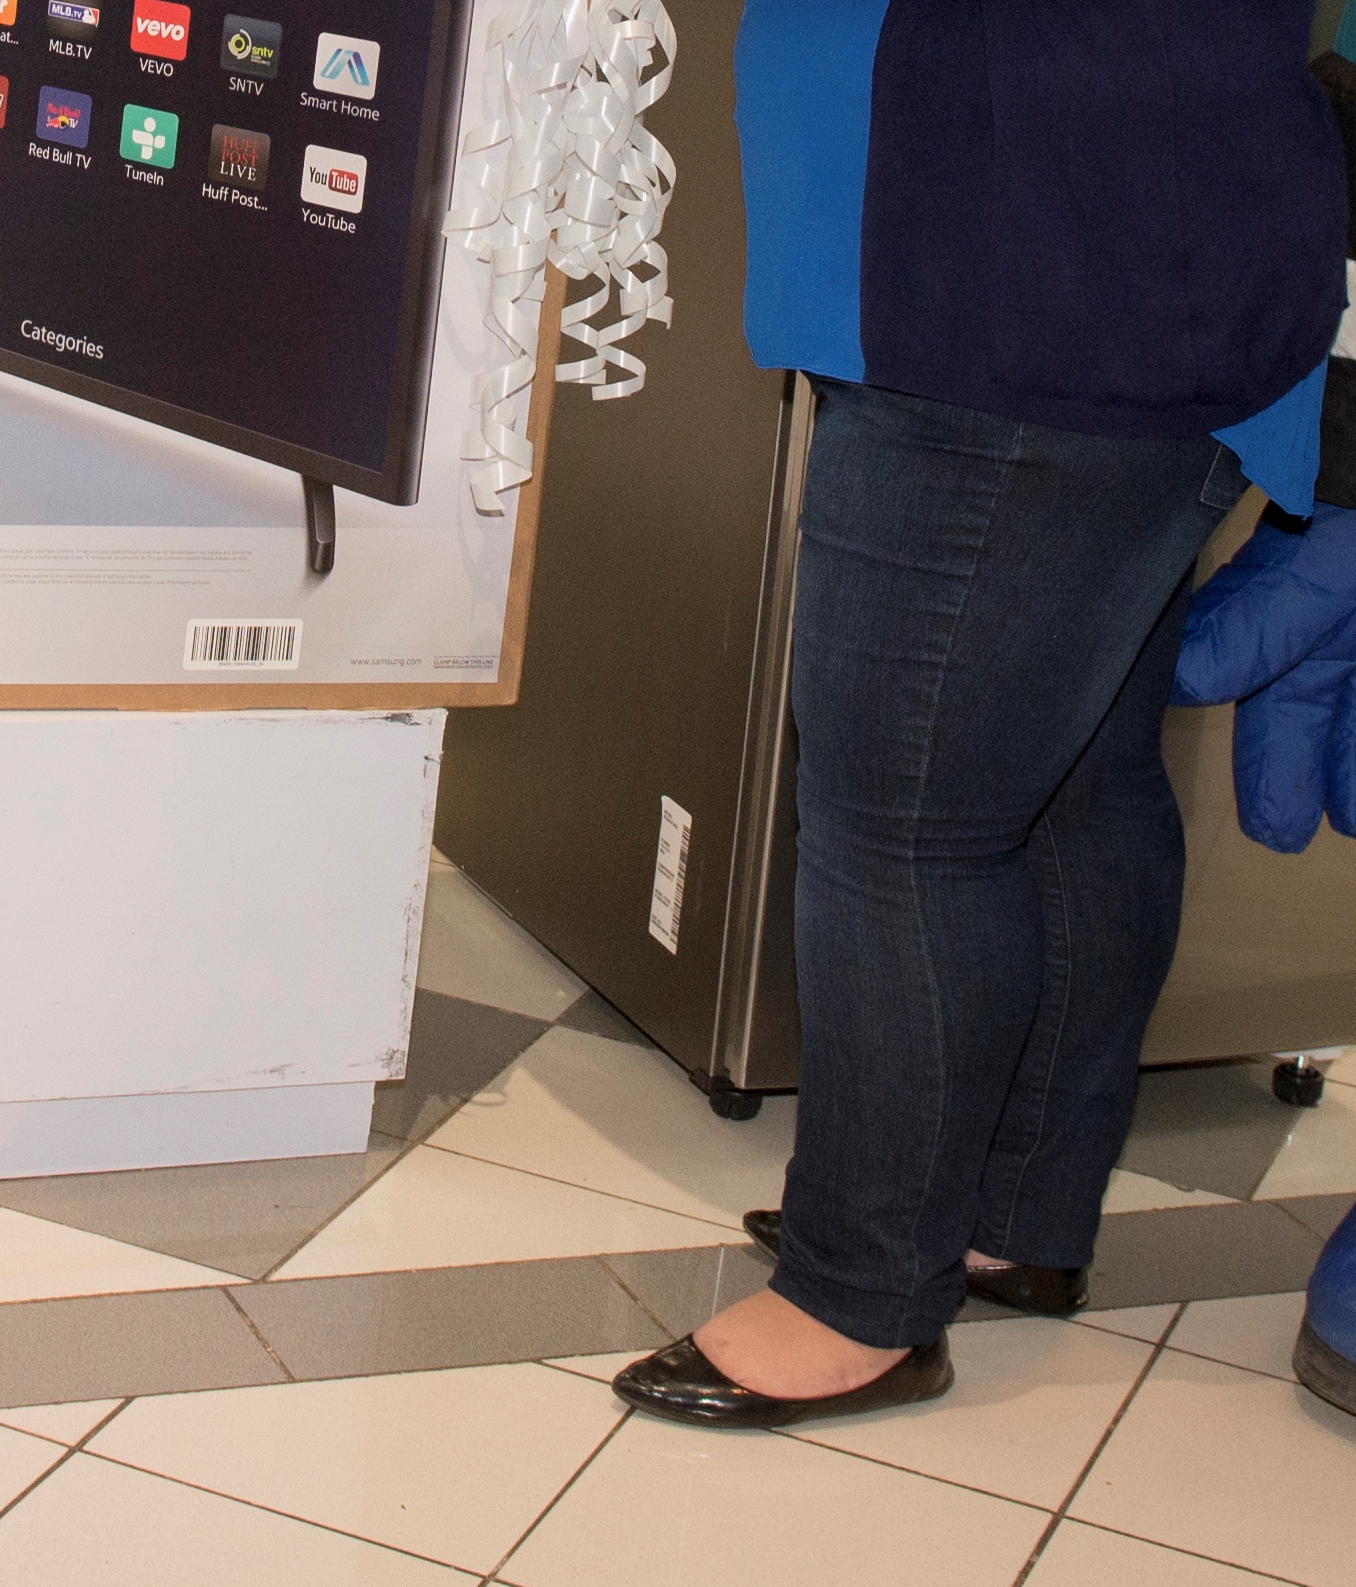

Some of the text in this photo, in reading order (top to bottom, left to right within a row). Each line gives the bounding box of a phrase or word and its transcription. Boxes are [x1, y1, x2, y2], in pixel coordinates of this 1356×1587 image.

[136, 17, 185, 41] vevo
[49, 39, 92, 60] MLB.TV
[252, 47, 273, 58] sntv
[139, 58, 173, 78] VEVO
[229, 77, 264, 96] SNTV
[299, 92, 380, 121] Smart Home
[29, 143, 91, 169] Red Bull TV
[124, 164, 164, 186] TuneIn
[219, 161, 258, 182] LIVE
[202, 183, 268, 211] Huff Post...
[301, 207, 356, 234] YouTube
[21, 318, 105, 361] Categories
[350, 656, 422, 667] www.samsung.com
